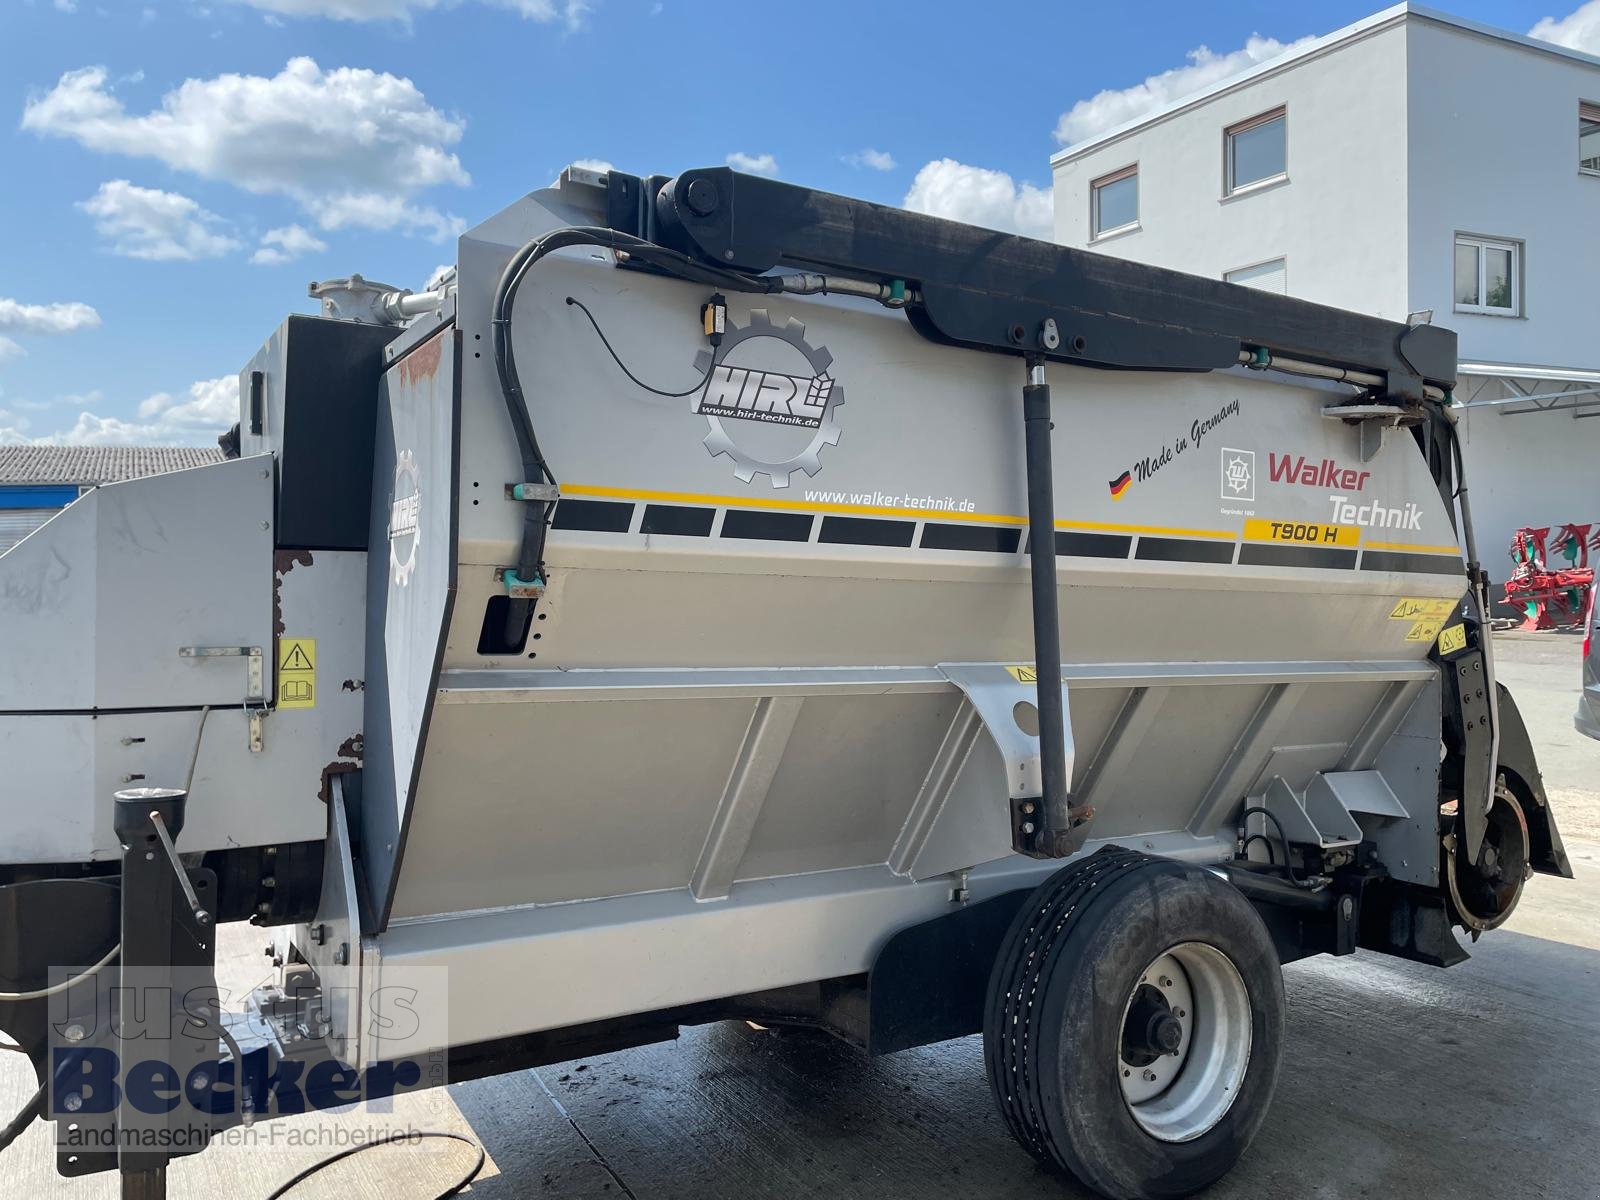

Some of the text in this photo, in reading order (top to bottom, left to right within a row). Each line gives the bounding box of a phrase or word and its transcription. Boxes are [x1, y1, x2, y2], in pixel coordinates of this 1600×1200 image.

[701, 364, 834, 419] HIRL
[701, 405, 820, 428] www.hirl-technik.de
[1133, 399, 1240, 482] Made in Germany
[1268, 452, 1371, 492] Walker
[804, 489, 976, 514] www.walker-technik.de
[1329, 495, 1424, 531] Technik
[1270, 522, 1339, 543] T900 H
